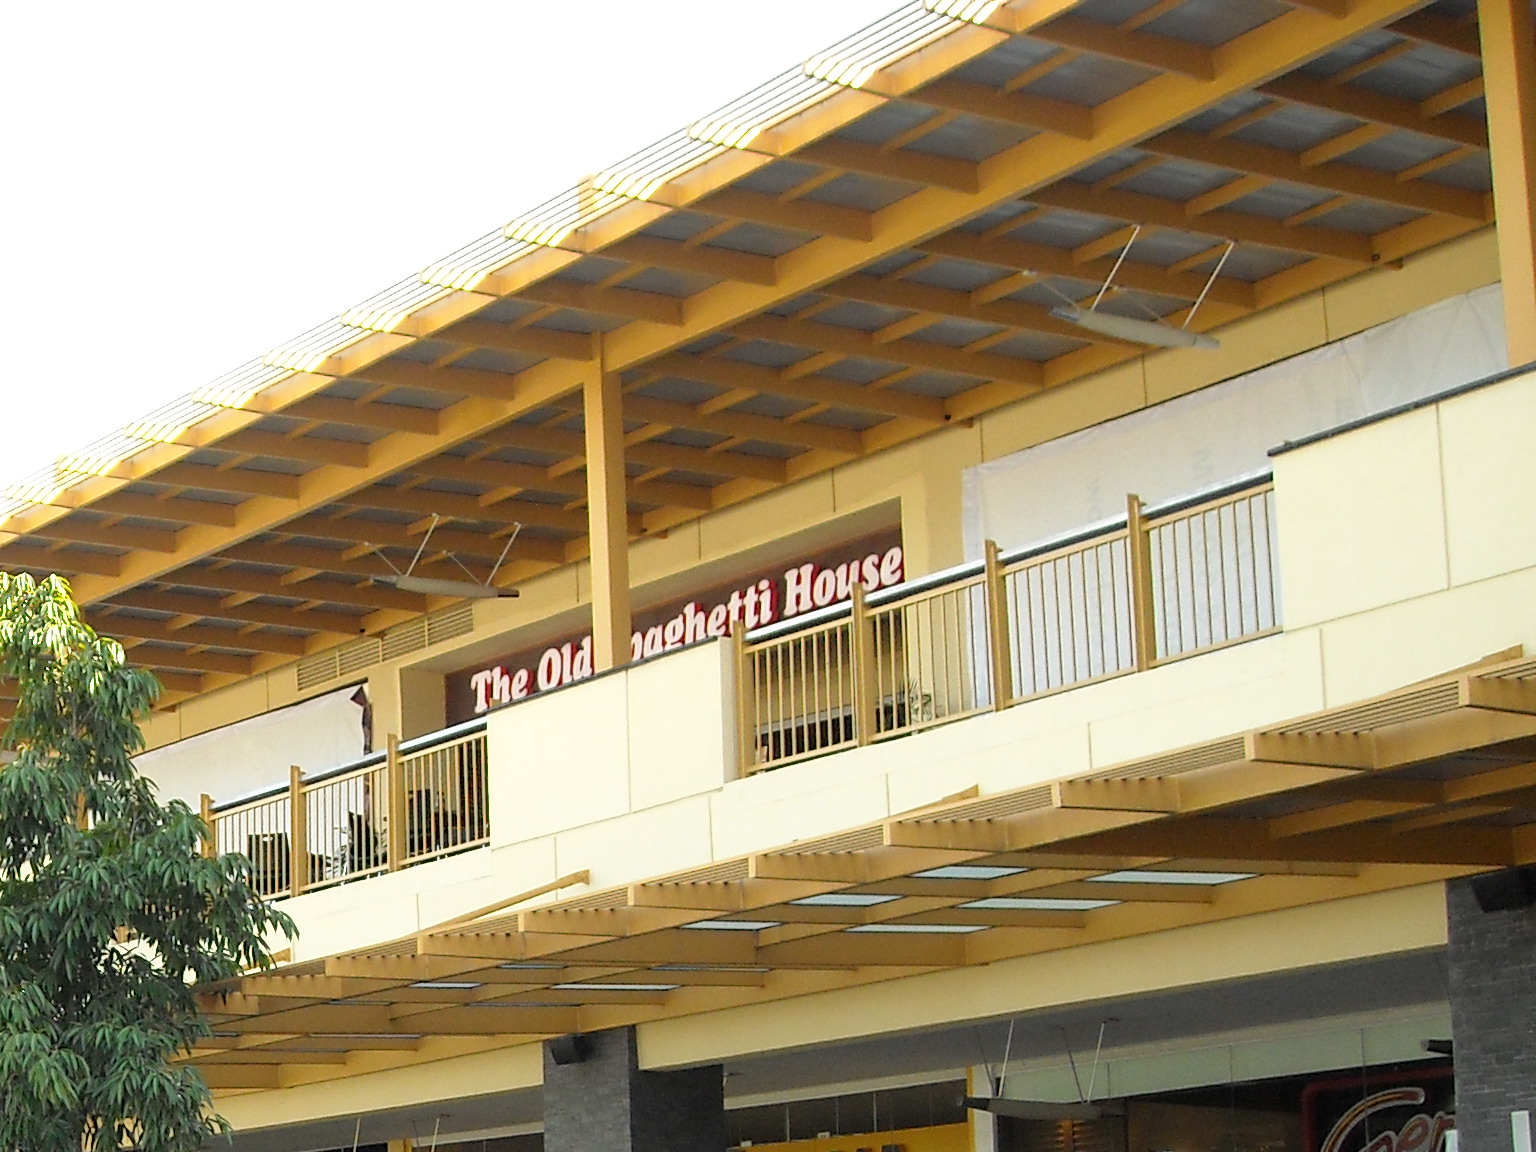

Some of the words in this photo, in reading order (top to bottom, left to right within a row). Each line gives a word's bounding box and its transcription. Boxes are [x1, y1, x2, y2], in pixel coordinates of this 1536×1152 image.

[470, 664, 534, 713] The
[537, 634, 593, 691] Old
[784, 546, 903, 616] House
